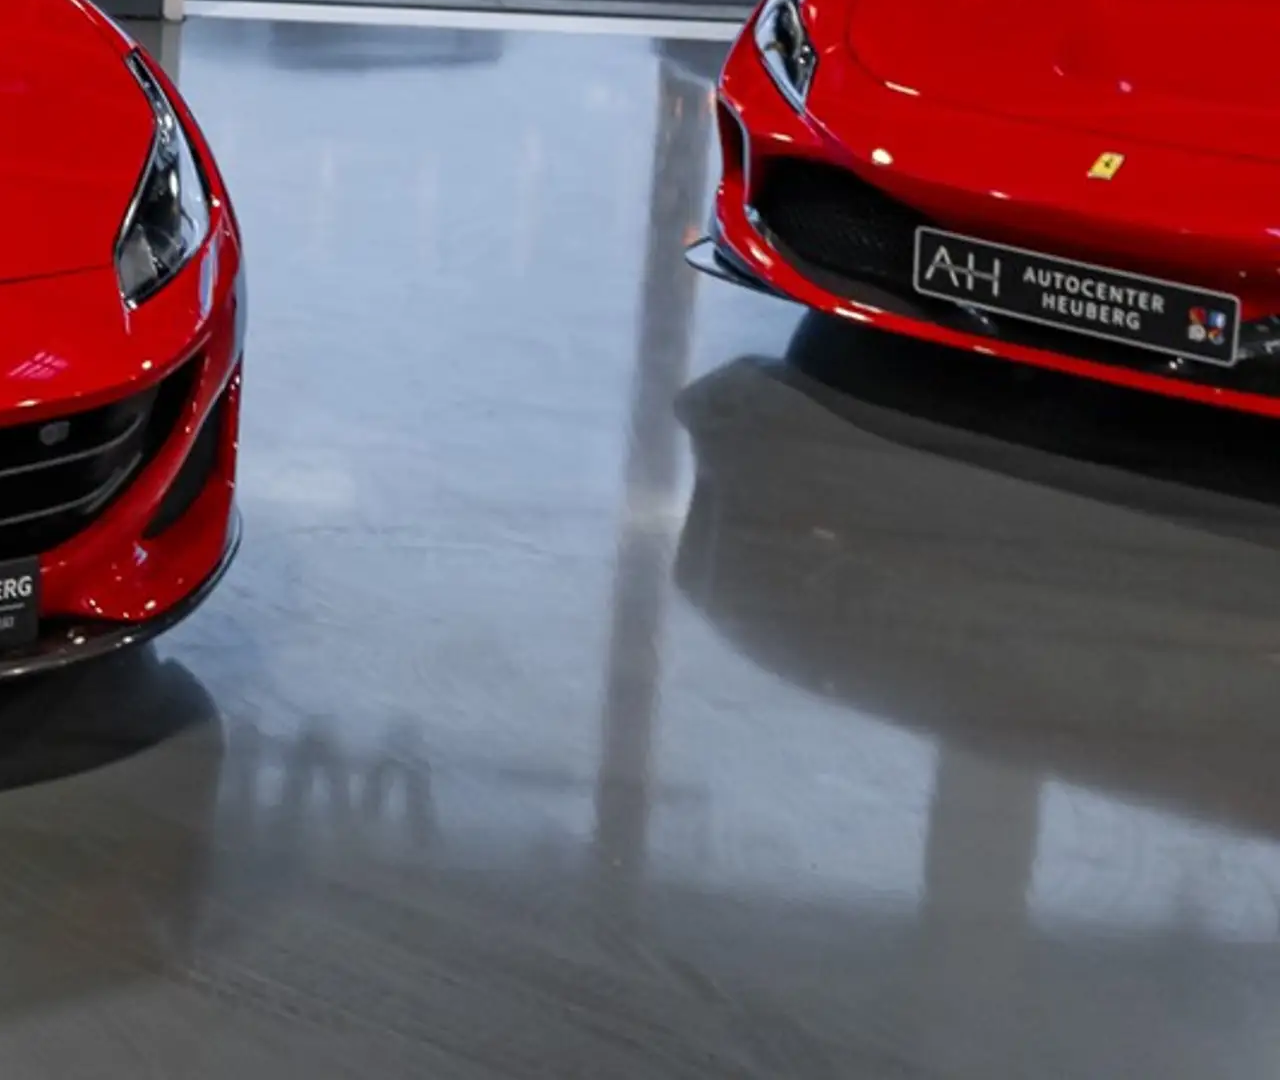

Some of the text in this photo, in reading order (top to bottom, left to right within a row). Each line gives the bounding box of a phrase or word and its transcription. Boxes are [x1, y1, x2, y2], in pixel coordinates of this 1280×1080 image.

[924, 244, 1001, 298] AH
[1022, 265, 1166, 314] AUTOCENTER
[1042, 291, 1142, 331] HEUBERG
